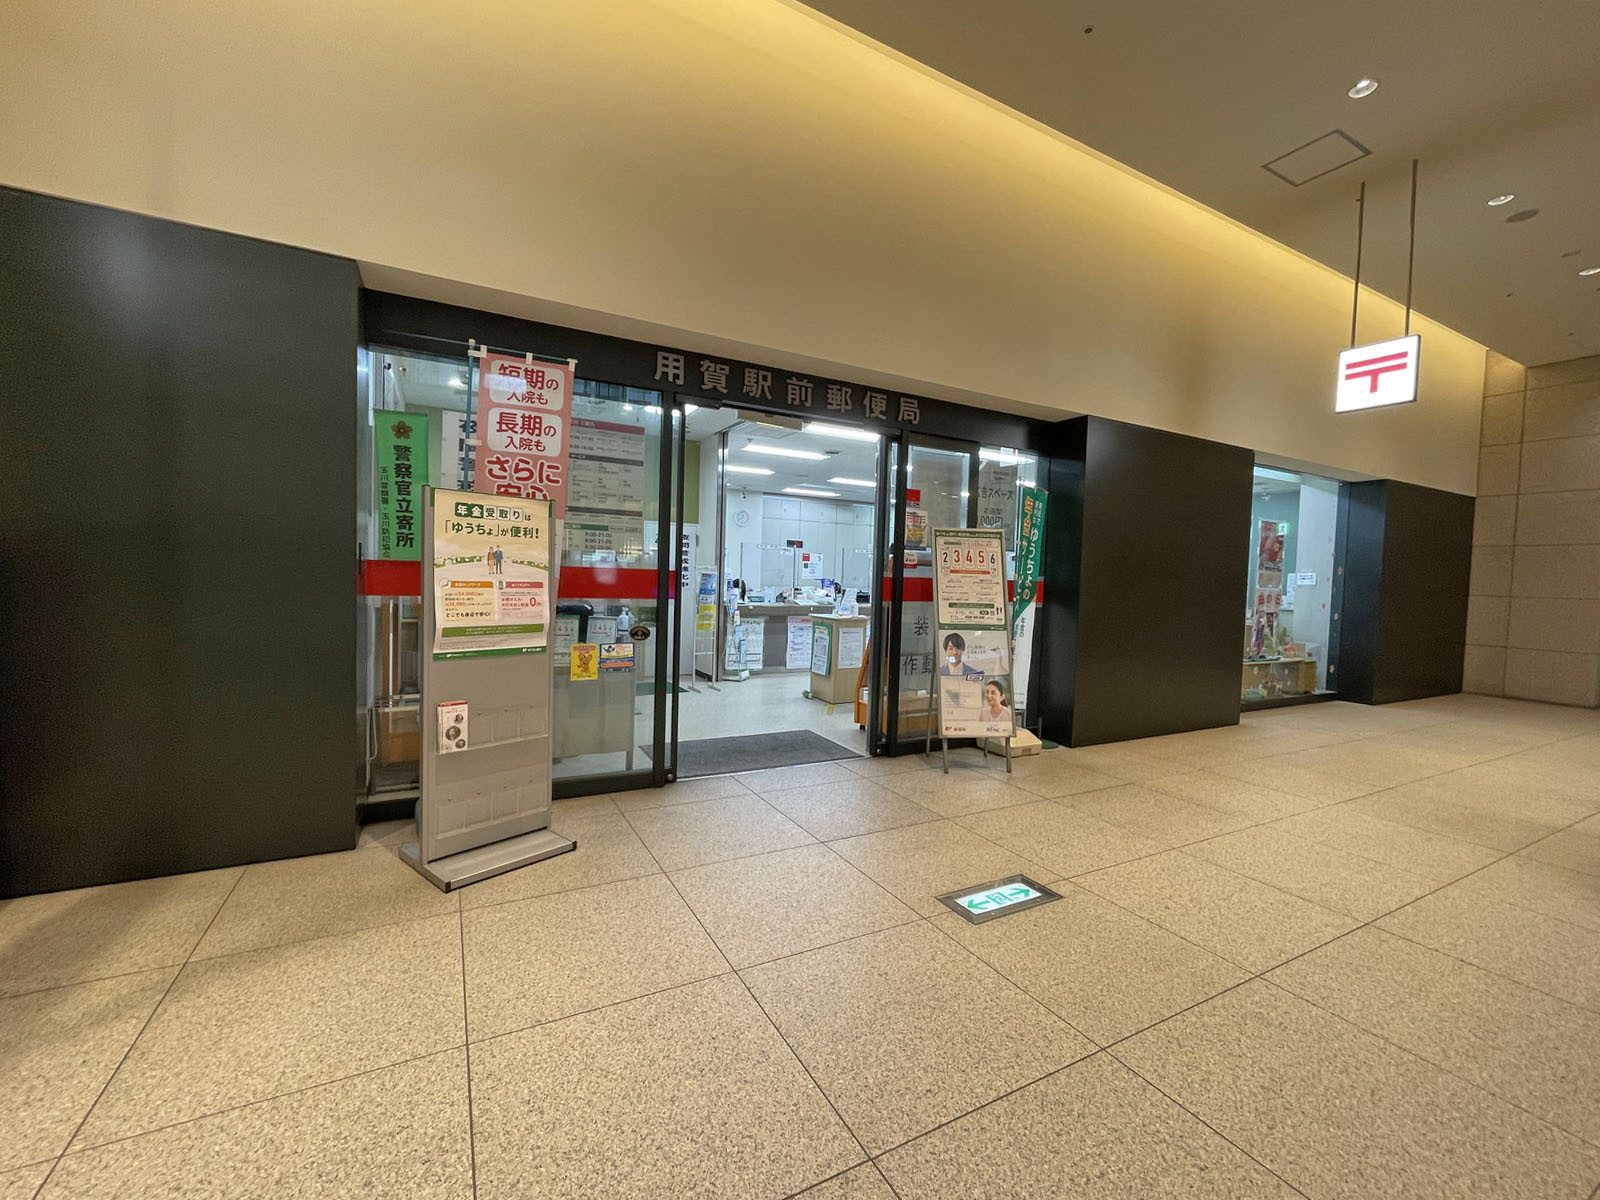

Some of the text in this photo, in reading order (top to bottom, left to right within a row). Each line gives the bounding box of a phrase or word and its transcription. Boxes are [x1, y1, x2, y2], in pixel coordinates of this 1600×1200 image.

[506, 390, 548, 406] 入院も
[654, 351, 921, 425] 用賀駅前郵便局
[496, 411, 557, 438] 長期の
[504, 435, 546, 452] 入院も
[486, 455, 562, 486] さらに
[393, 445, 415, 549] 警察官立寄所
[456, 503, 532, 521] 年金受取りは
[943, 549, 996, 564] 2 3 4 5 6
